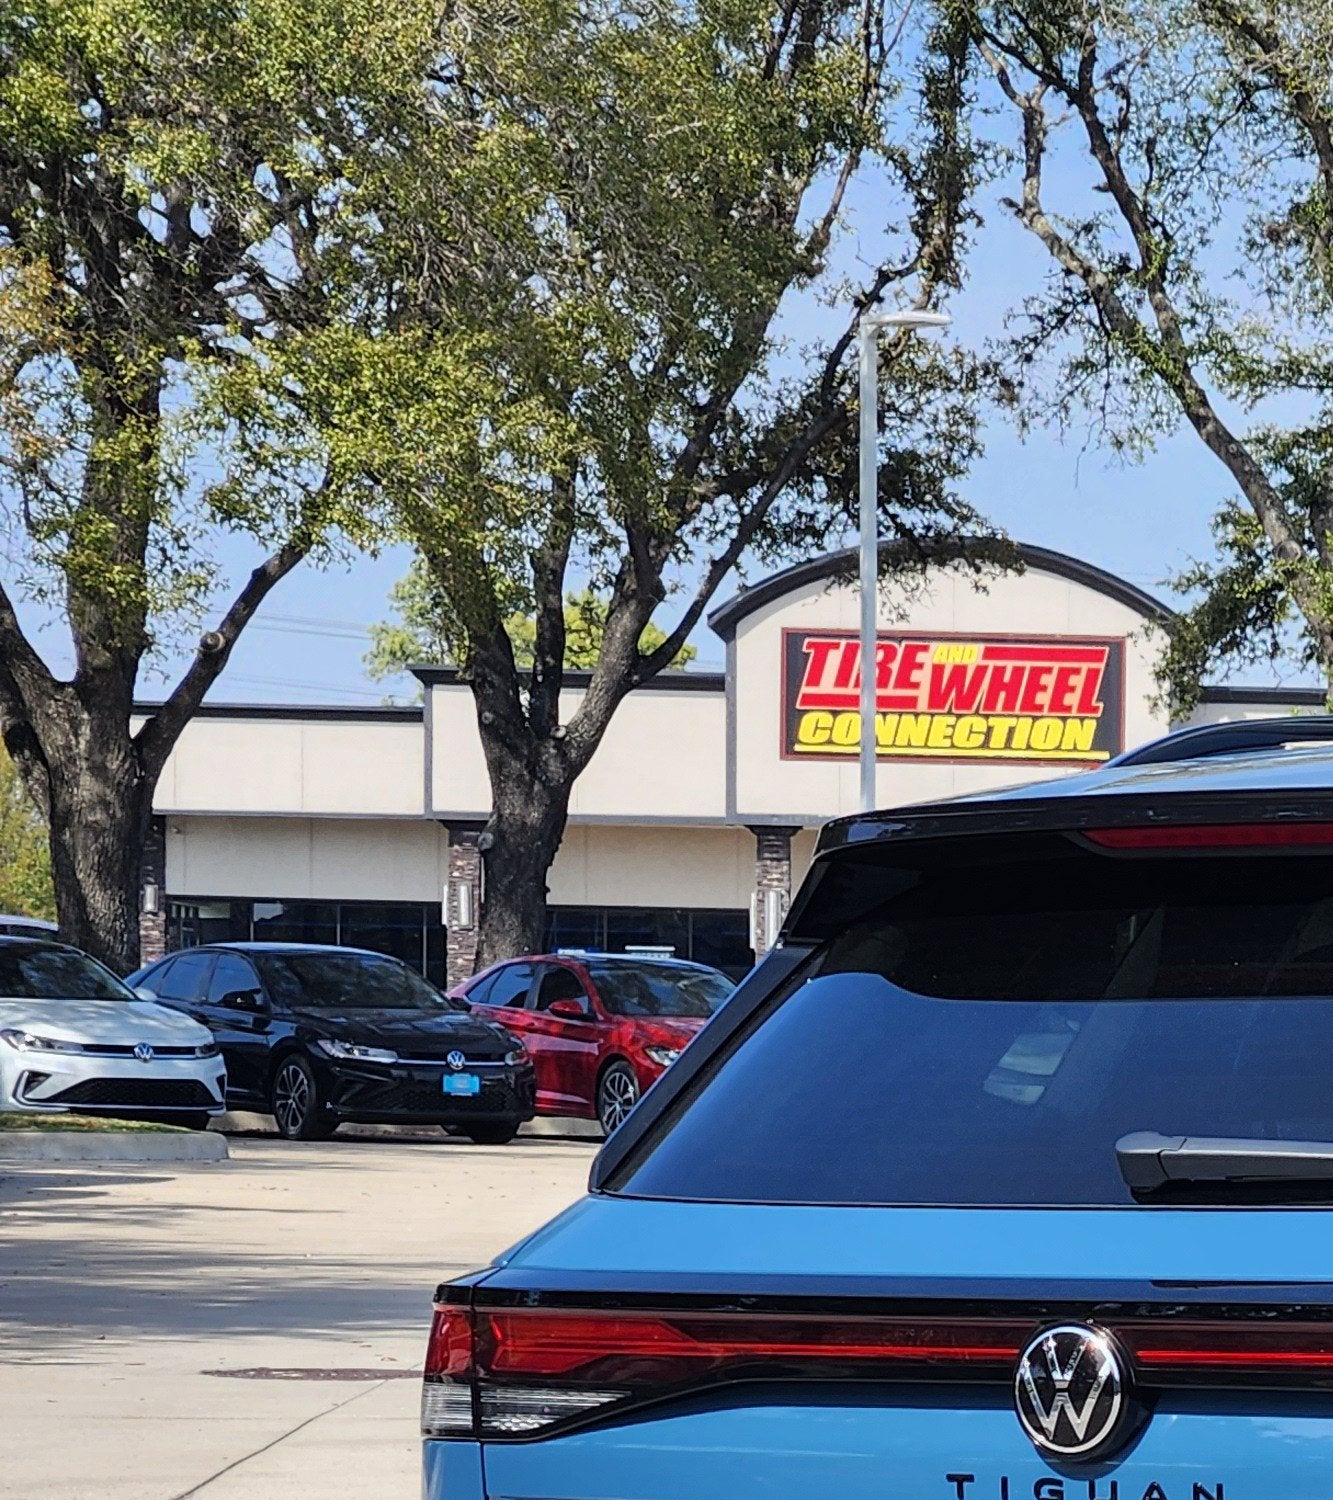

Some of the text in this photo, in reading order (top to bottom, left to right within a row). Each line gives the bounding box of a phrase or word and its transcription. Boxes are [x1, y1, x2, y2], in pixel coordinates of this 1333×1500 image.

[801, 639, 978, 690] TIRE AND
[928, 663, 1102, 716] WHEEL
[797, 711, 1097, 750] CONNECTION
